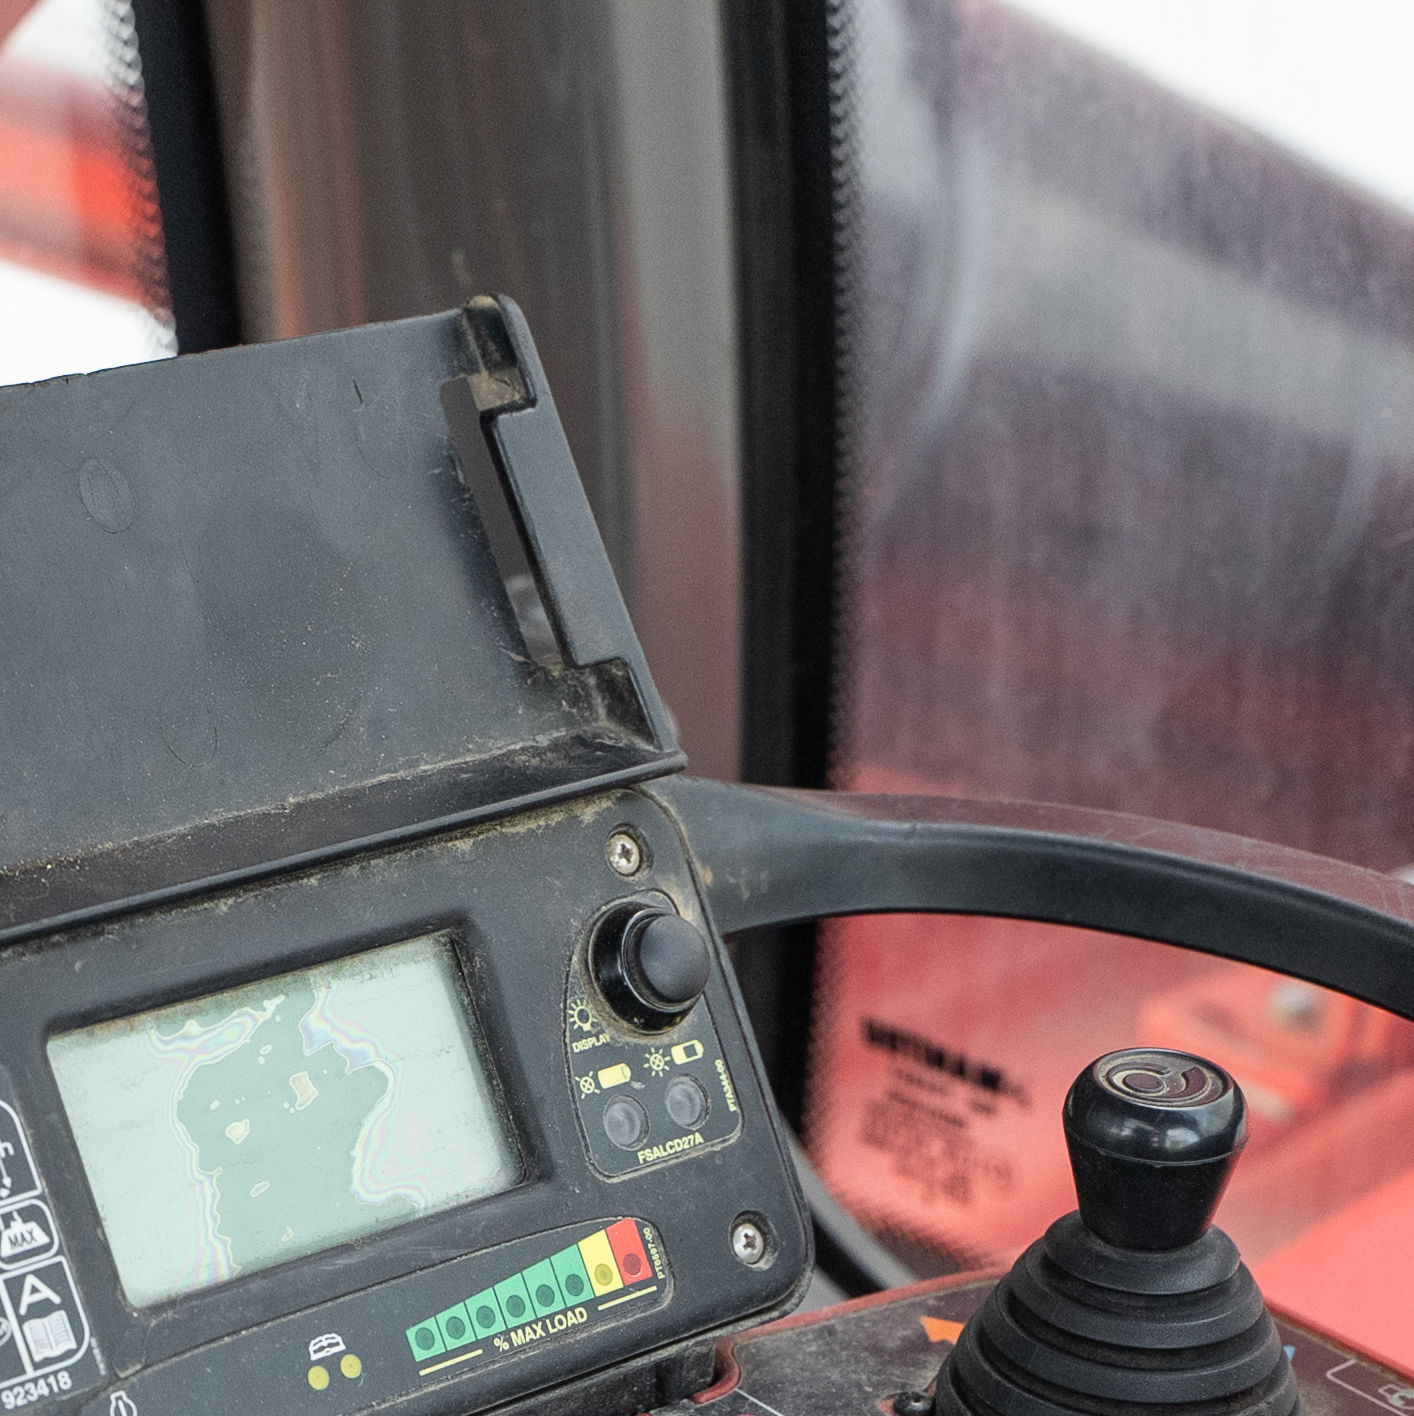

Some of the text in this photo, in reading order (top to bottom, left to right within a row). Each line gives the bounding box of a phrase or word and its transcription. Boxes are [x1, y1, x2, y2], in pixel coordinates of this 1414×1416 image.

[572, 1033, 610, 1053] DISPLAY
[637, 1131, 704, 1164] FSALCD27A
[8, 1228, 38, 1250] MAX
[19, 1274, 61, 1316] A
[493, 1307, 587, 1352] % MAX LOAD
[1, 1371, 72, 1410] 923418
